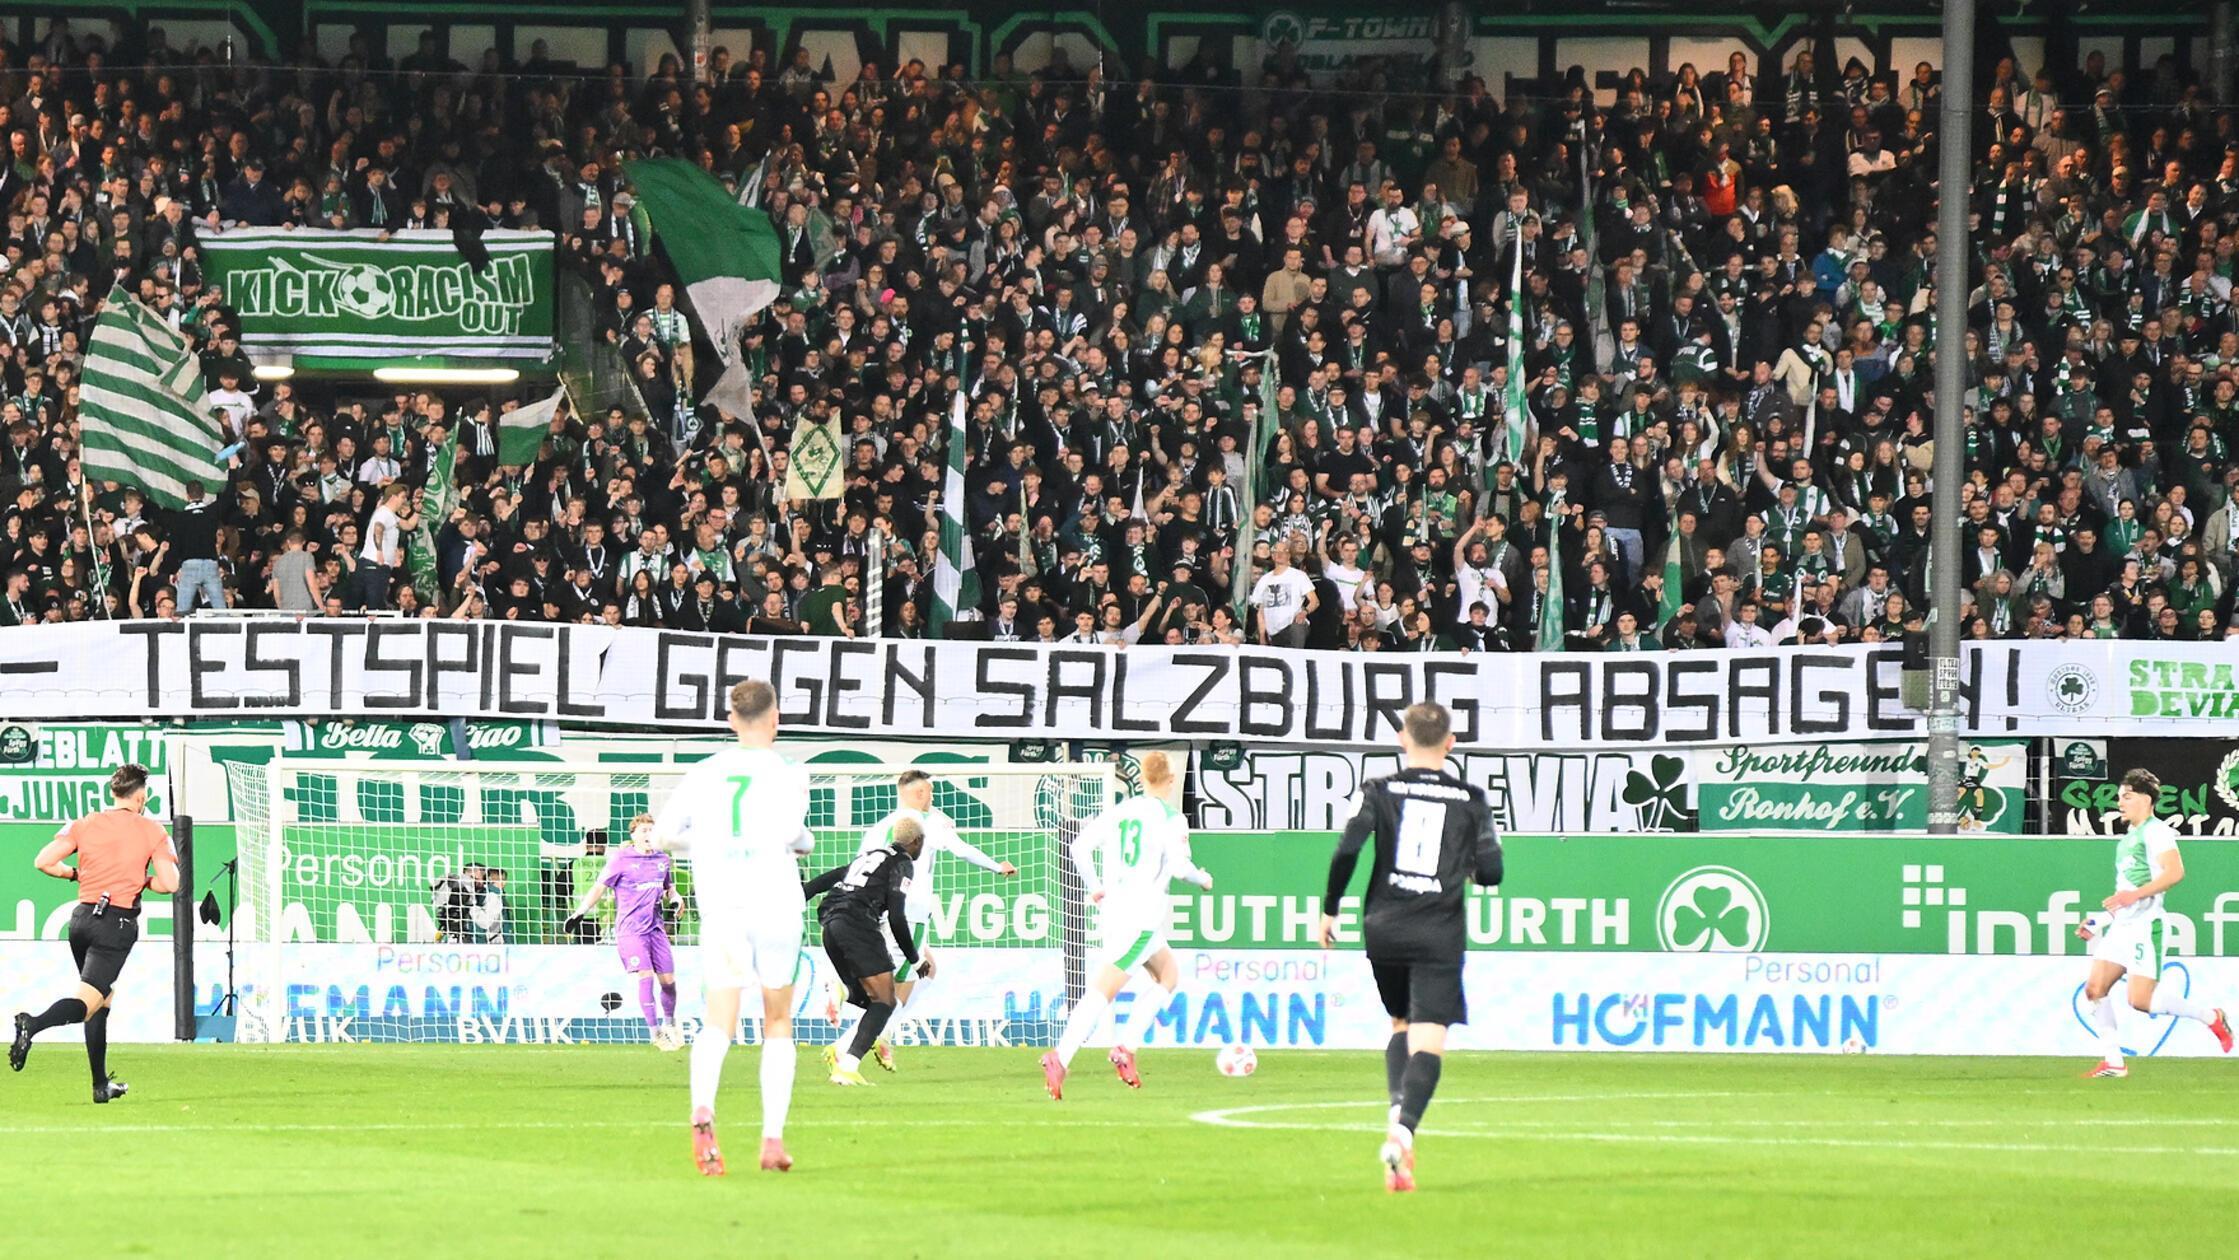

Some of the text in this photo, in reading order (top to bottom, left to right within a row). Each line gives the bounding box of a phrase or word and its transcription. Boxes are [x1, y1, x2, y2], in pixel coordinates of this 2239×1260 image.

[227, 253, 534, 320] KICK RACISM
[459, 300, 523, 336] OUT
[120, 622, 605, 716] TESTSPIEL
[656, 632, 935, 728] GEGEN
[976, 648, 1478, 743] SALZBURG
[2130, 659, 2235, 690] STRA
[0, 730, 165, 768] EBLATT
[321, 721, 402, 749] Bella
[1716, 745, 1916, 781] Sportfreund
[726, 775, 752, 837] 7
[1202, 752, 1635, 833] STREVIA
[1719, 787, 1915, 829] Ronhof e.V.
[2061, 780, 2208, 819] GREN
[1119, 819, 1142, 867] 13
[930, 893, 1050, 942] VGG
[1467, 886, 1630, 944] ÜRTH
[377, 947, 510, 974] Personal
[1195, 953, 1328, 981] Personal
[1745, 956, 1881, 984] Personal
[2136, 943, 2144, 961] 5
[458, 1017, 575, 1045] BVUK
[899, 1019, 1010, 1047] BVUK
[1553, 992, 1878, 1047] HOFMANN
